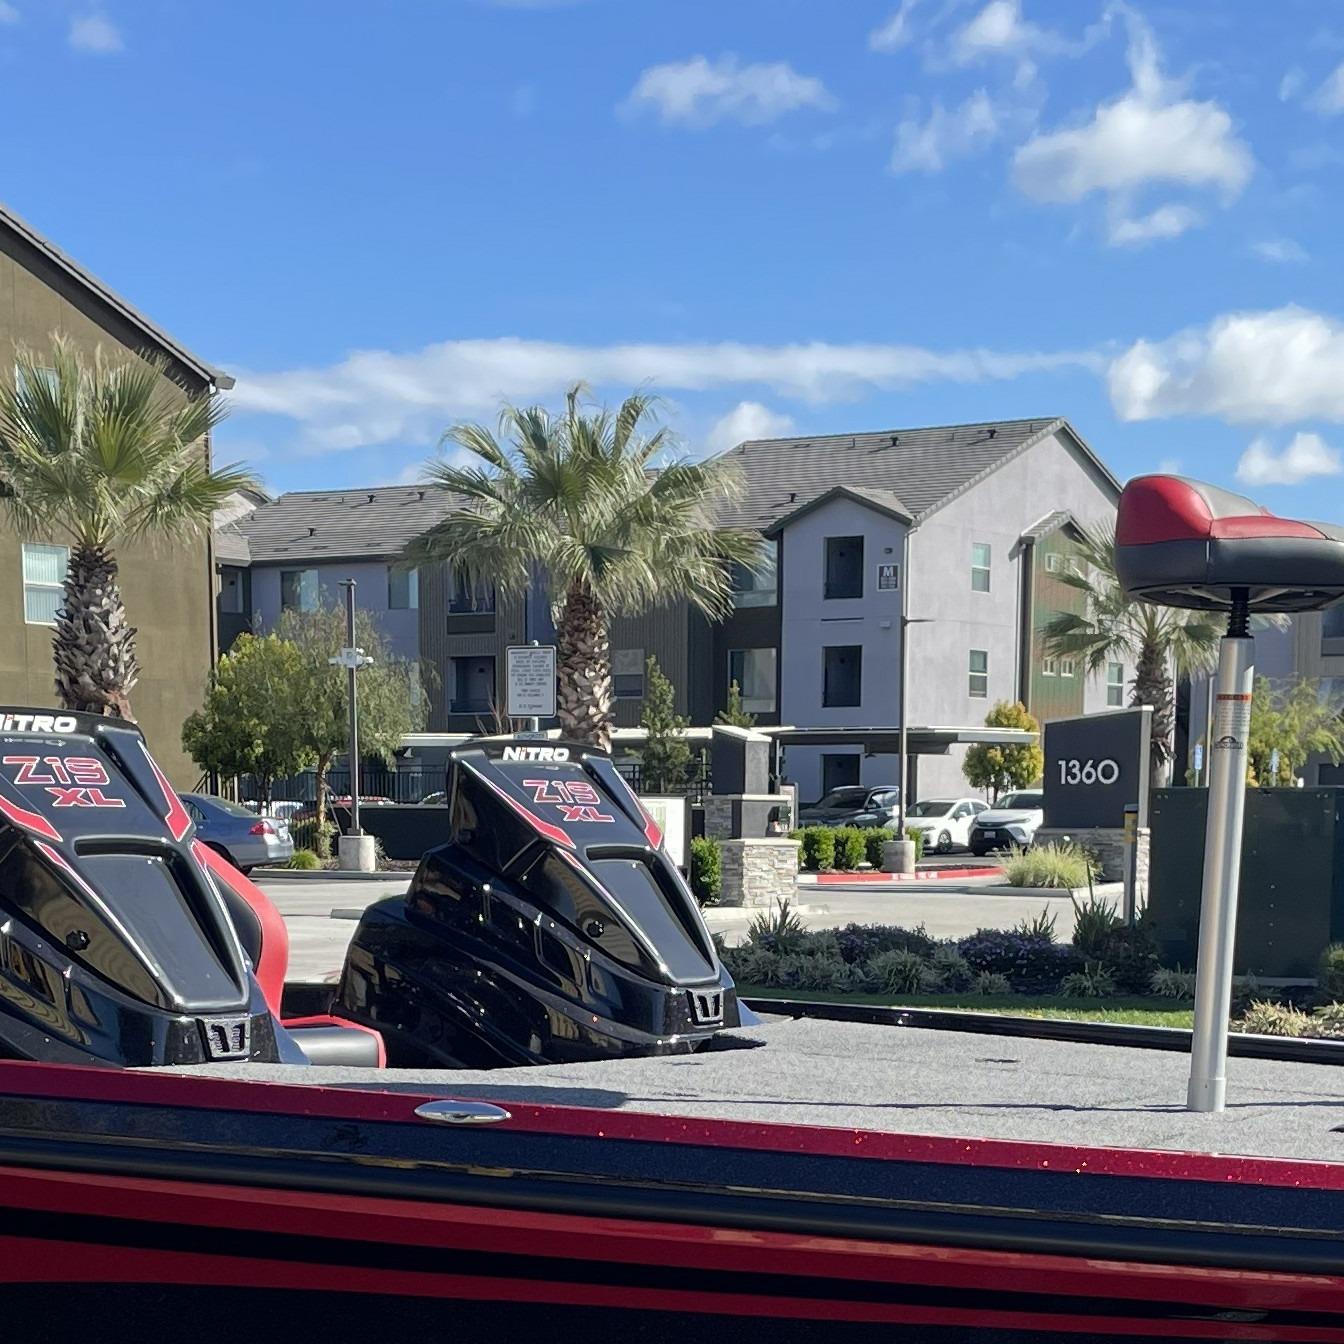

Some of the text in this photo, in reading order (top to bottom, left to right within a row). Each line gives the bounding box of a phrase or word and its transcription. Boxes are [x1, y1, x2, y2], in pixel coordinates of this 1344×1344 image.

[1058, 759, 1119, 785] 1360
[44, 787, 126, 807] XL
[556, 805, 616, 823] XL
